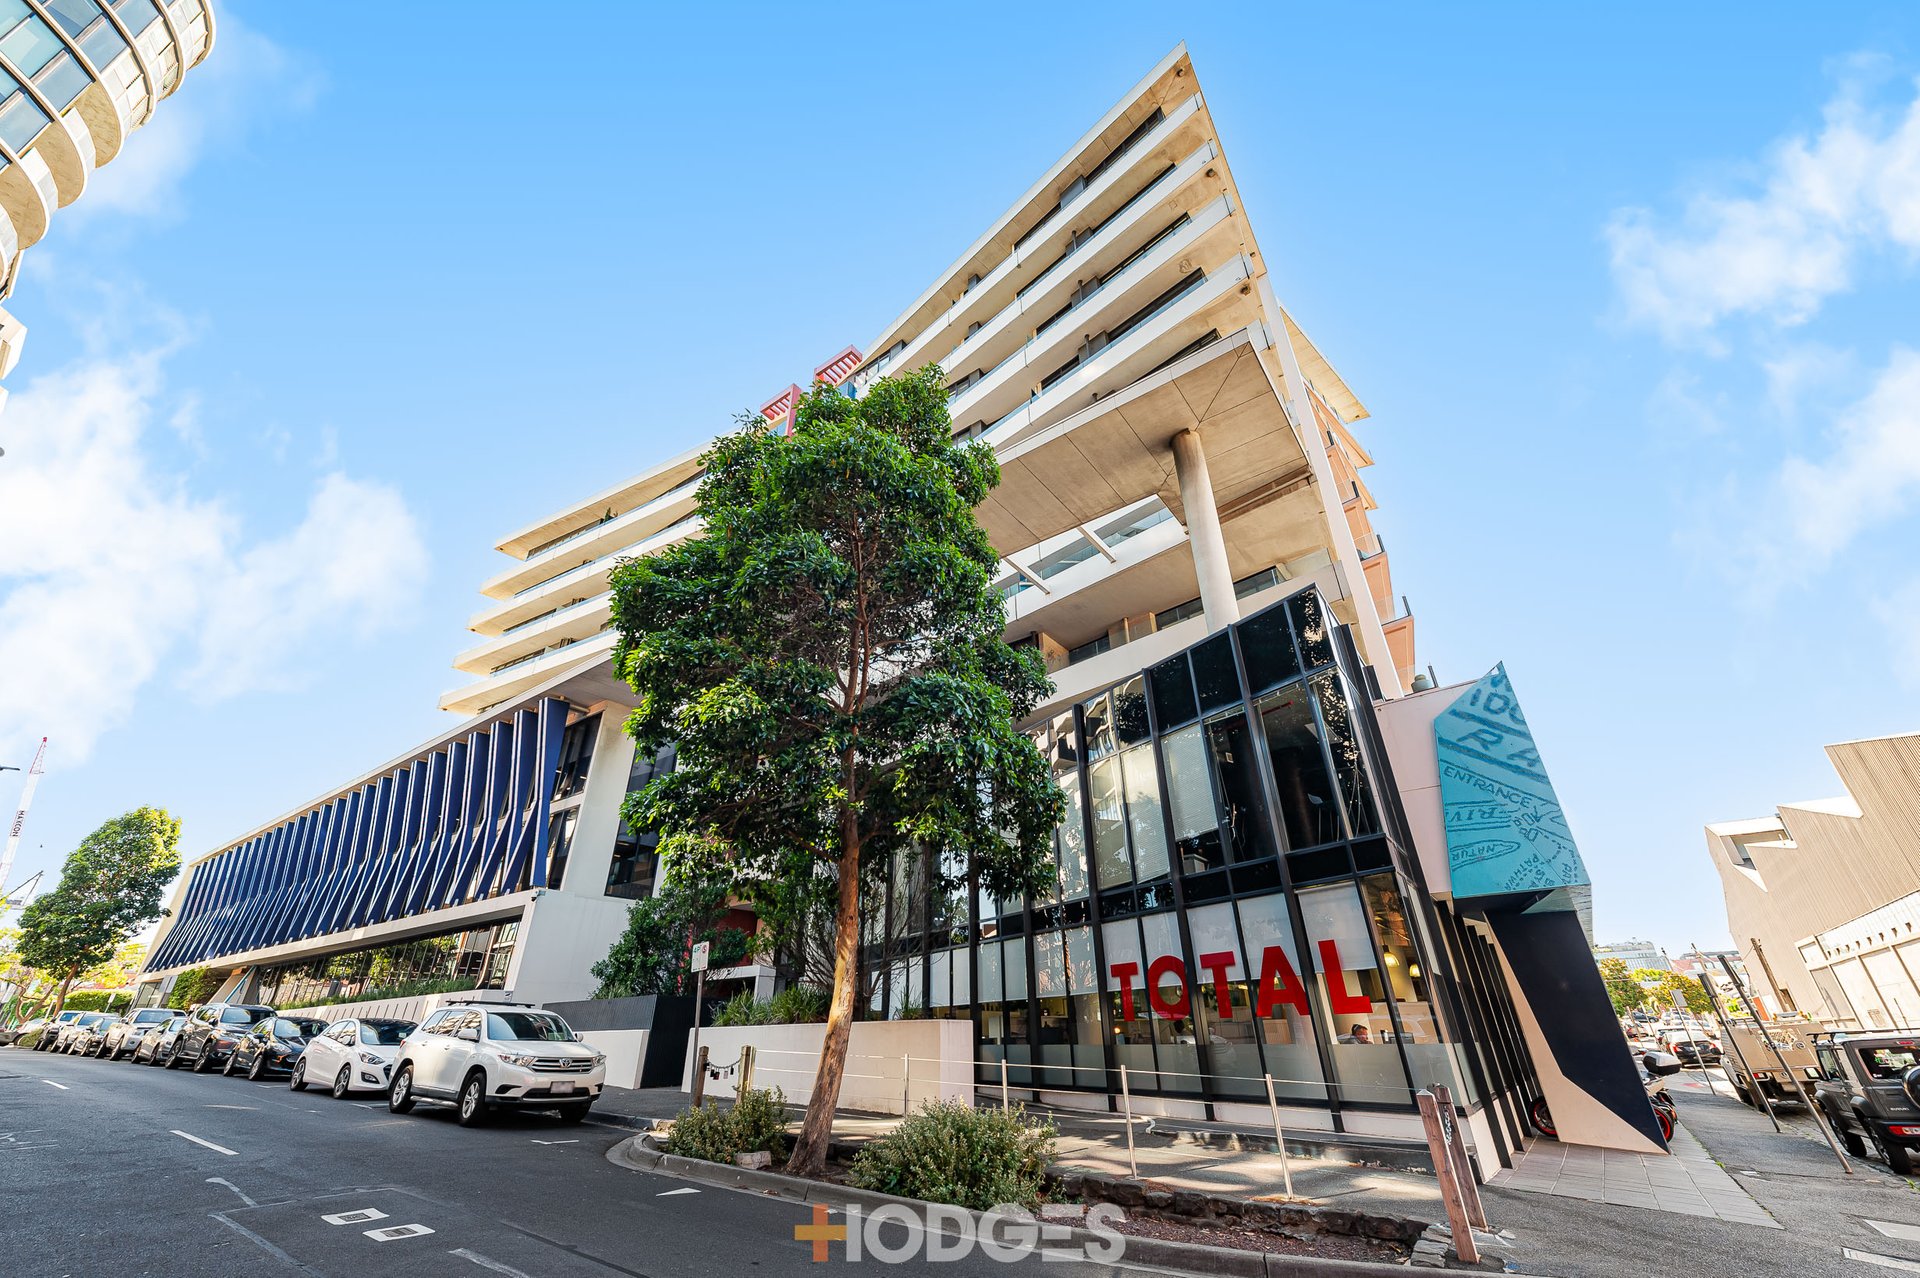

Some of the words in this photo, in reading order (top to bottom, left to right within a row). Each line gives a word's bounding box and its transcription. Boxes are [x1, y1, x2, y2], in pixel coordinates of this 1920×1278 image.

[1443, 765, 1533, 809] ENTRANCE
[11, 809, 25, 837] MAXCON
[1110, 938, 1374, 1022] TOTAL
